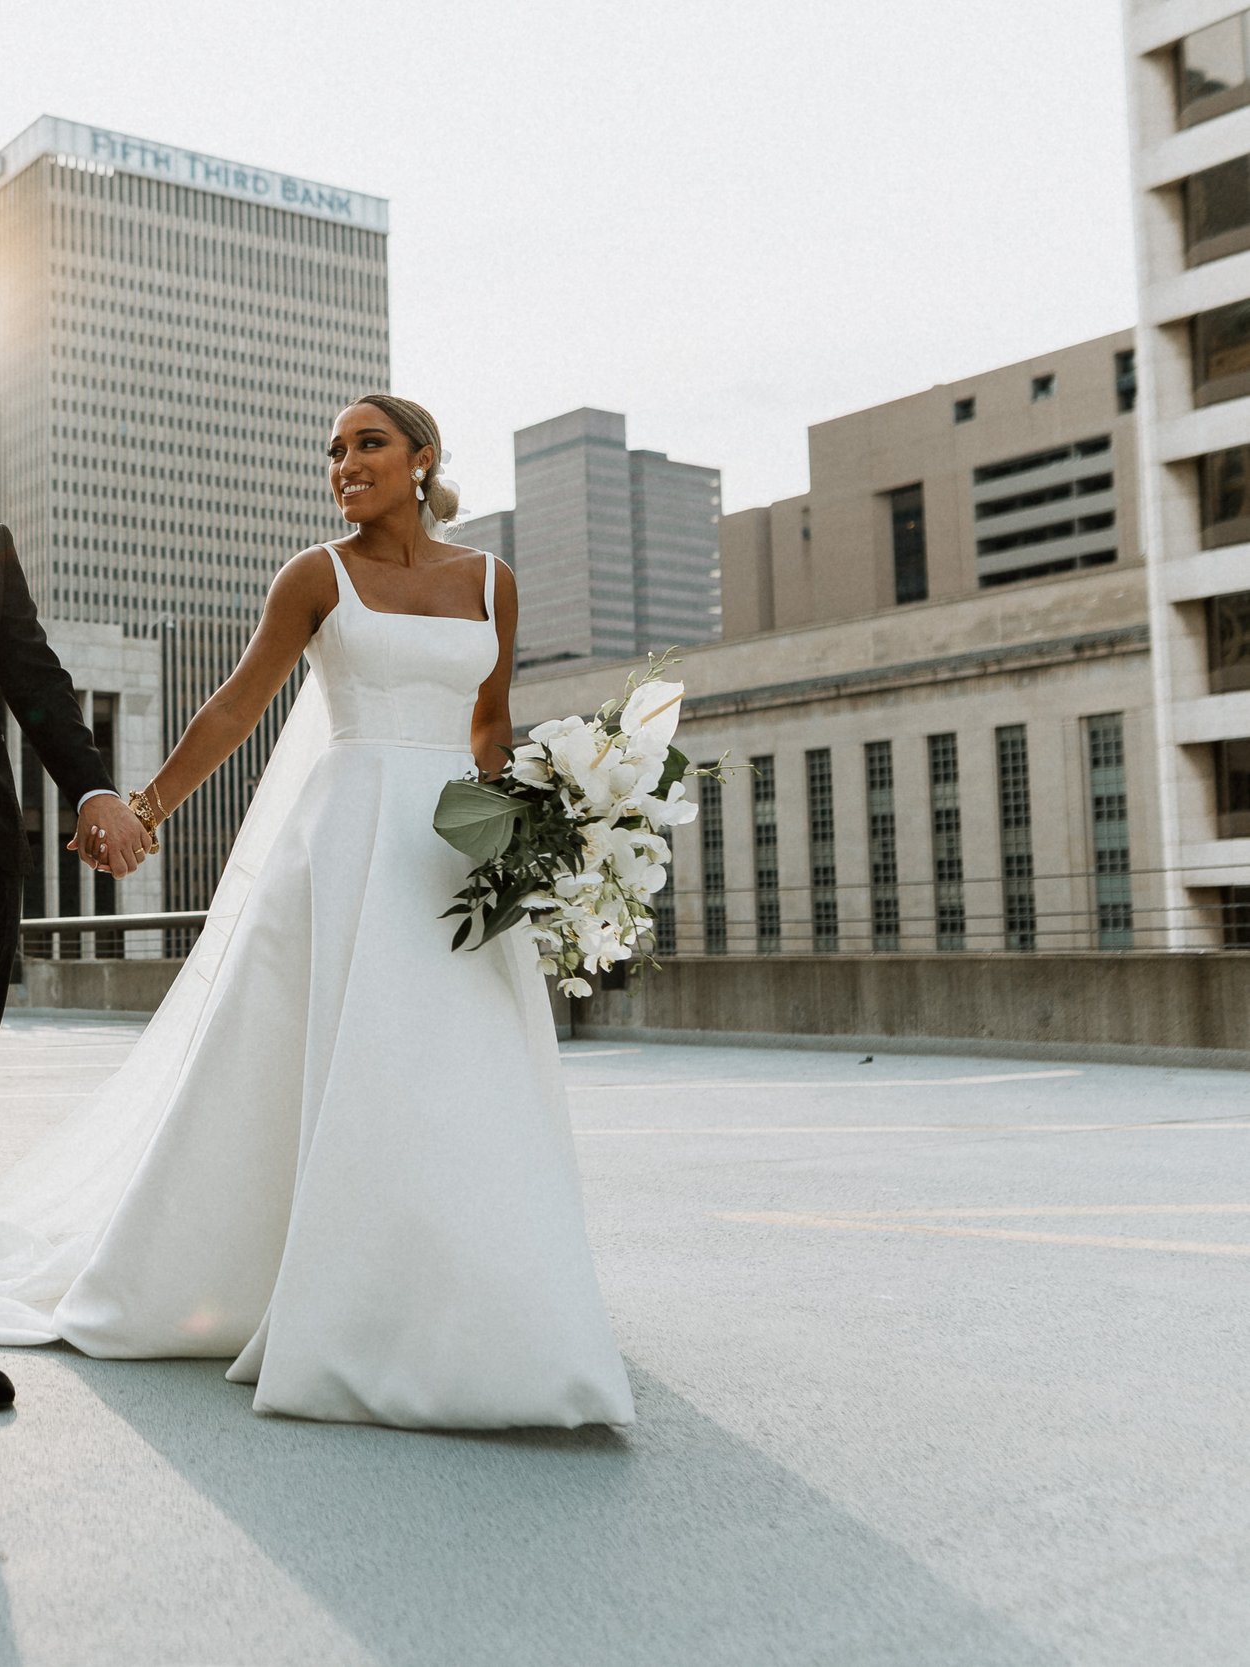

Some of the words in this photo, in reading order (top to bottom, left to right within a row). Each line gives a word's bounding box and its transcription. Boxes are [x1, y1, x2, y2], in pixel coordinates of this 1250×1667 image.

[92, 131, 171, 172] FIFTH
[184, 150, 270, 195] THIRD
[281, 174, 352, 217] BANK
